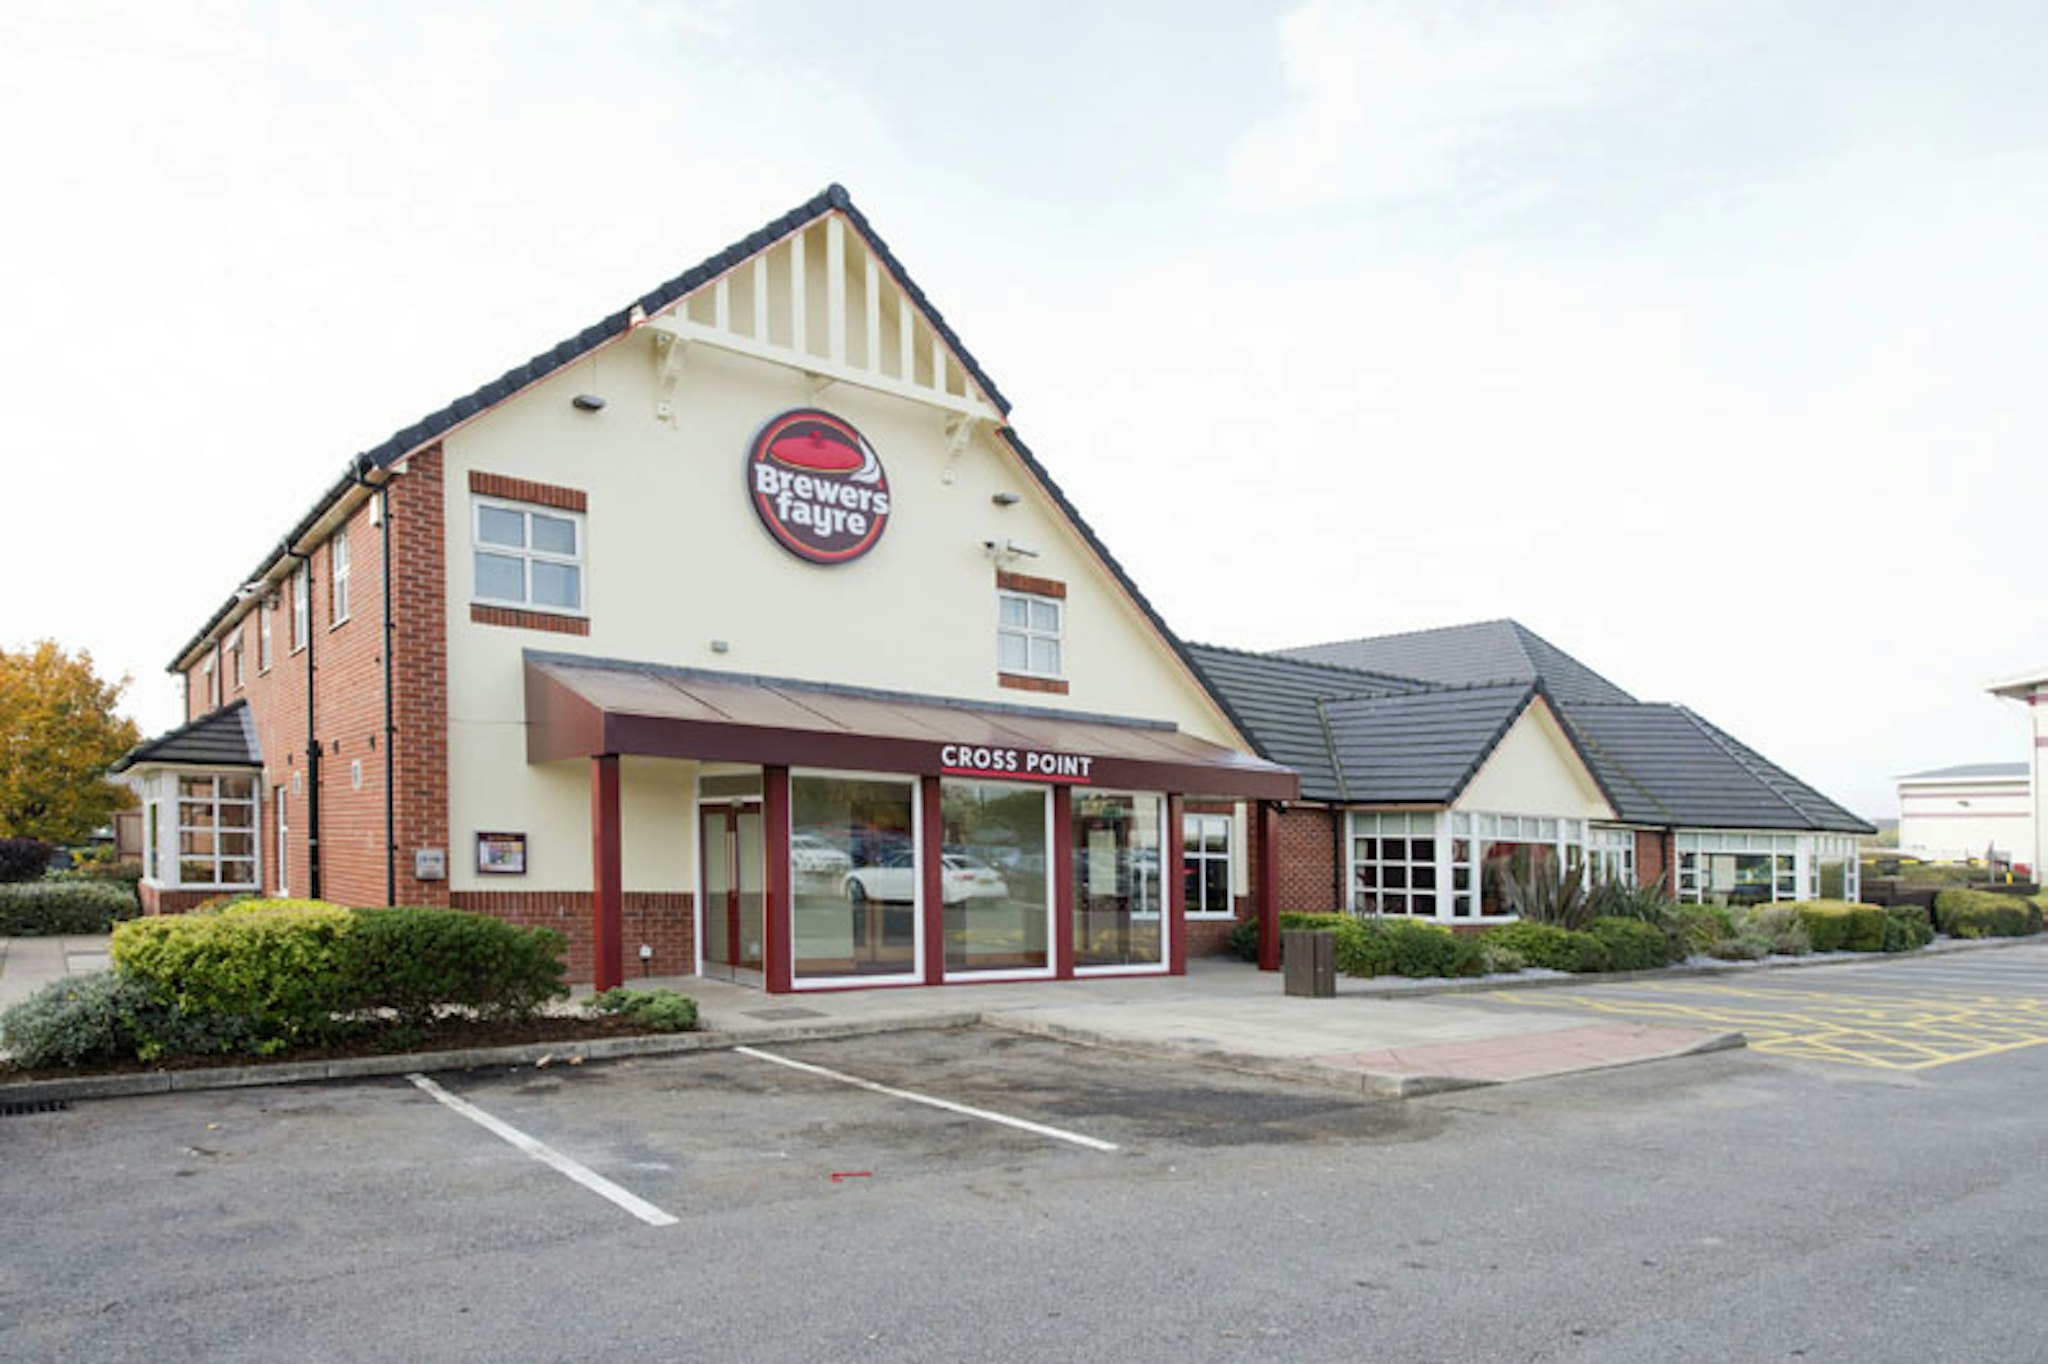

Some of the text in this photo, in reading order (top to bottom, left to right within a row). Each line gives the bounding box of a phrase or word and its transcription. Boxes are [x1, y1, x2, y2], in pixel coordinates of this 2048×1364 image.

[754, 463, 889, 515] Brewers
[776, 490, 867, 537] fayre
[941, 745, 1092, 776] CROSS POINT
